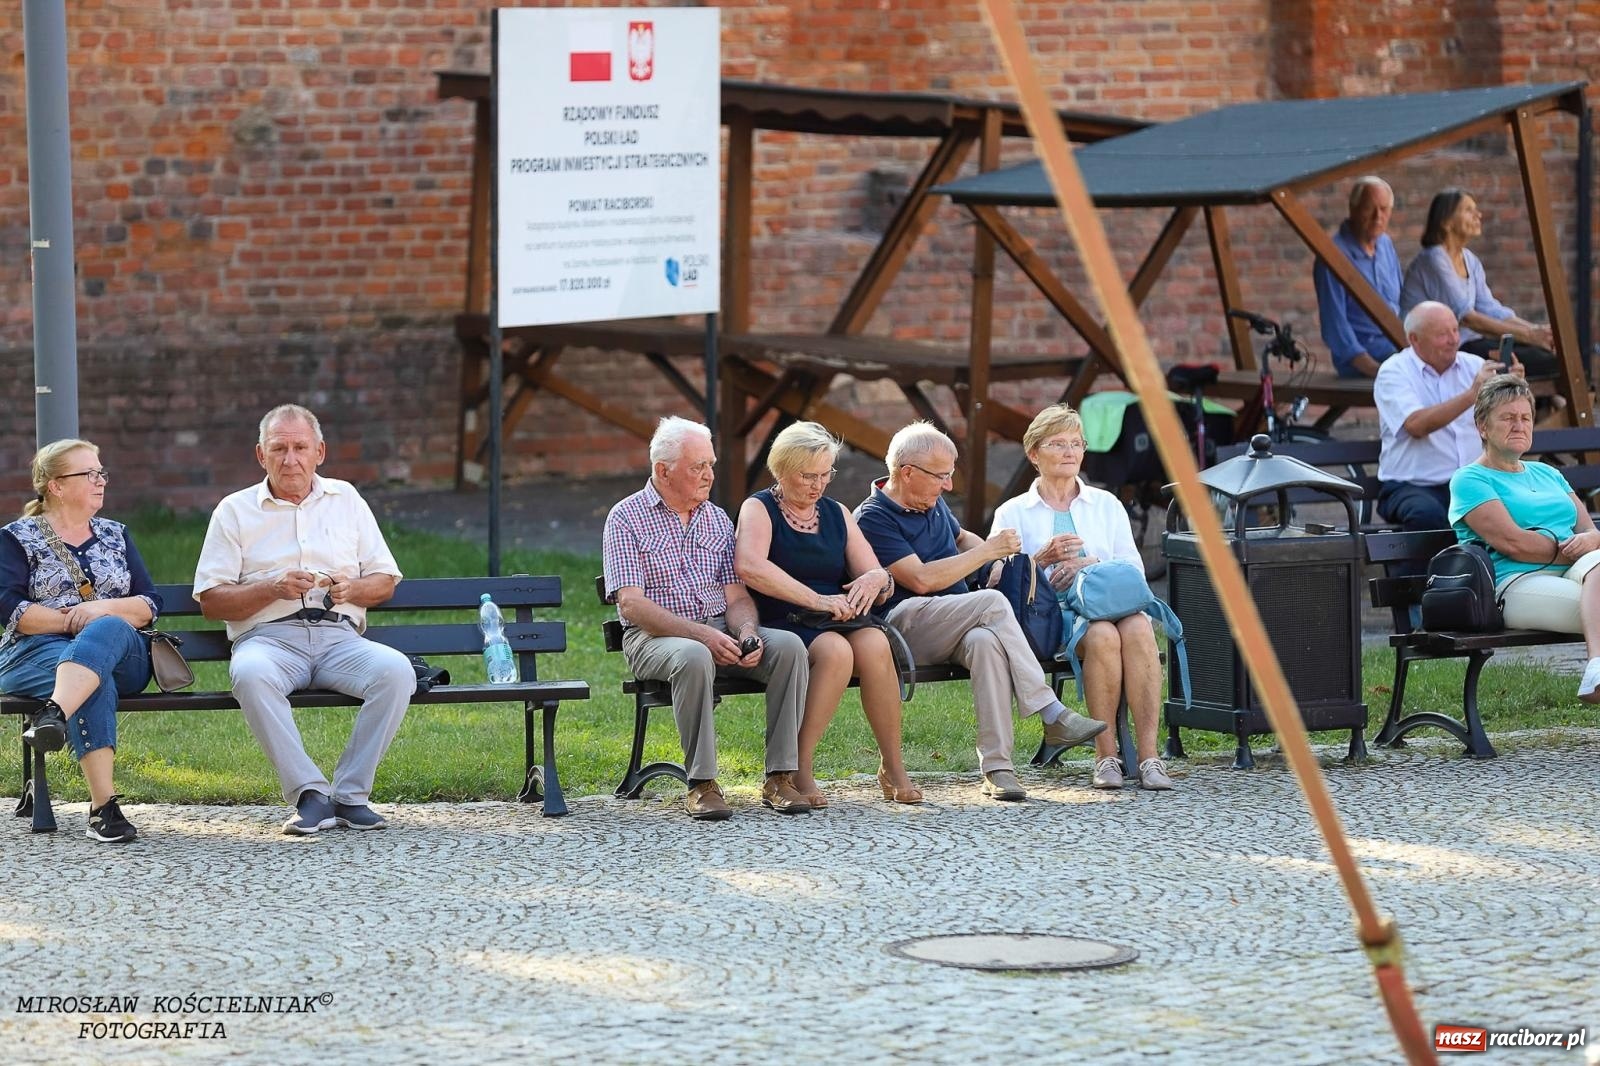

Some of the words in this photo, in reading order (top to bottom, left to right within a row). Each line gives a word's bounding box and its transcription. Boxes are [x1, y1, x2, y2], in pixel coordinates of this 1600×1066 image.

[615, 103, 660, 120] FUNDUSZ
[584, 129, 617, 145] POLSKI
[511, 157, 561, 174] PROGRAM
[564, 154, 622, 172] INWESTYCJI
[624, 151, 708, 169] STRATEGICZNYCH
[568, 198, 602, 213] POWIAT
